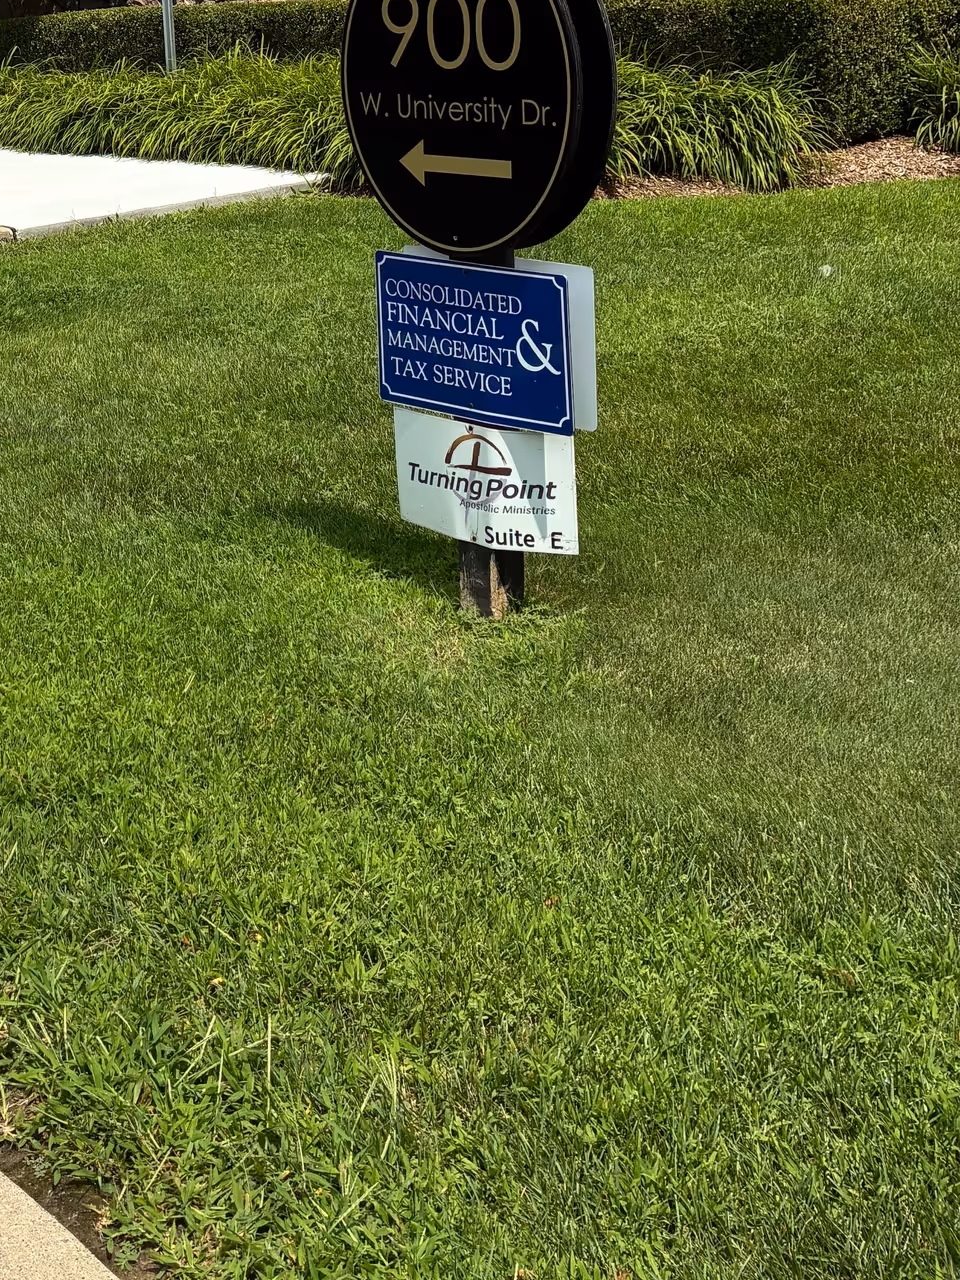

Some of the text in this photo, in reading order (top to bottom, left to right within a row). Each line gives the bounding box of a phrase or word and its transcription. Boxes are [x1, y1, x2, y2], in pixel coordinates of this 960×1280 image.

[360, 91, 557, 130] W. University Dr.
[385, 278, 522, 315] CONSOLIDATED
[386, 301, 505, 340] FINANCIAL
[387, 328, 516, 368] MANAGEMENT
[515, 318, 561, 376] &
[390, 356, 513, 396] TAX SERVICE
[459, 499, 556, 515] Apostolic Ministries
[484, 525, 564, 549] Suite E
